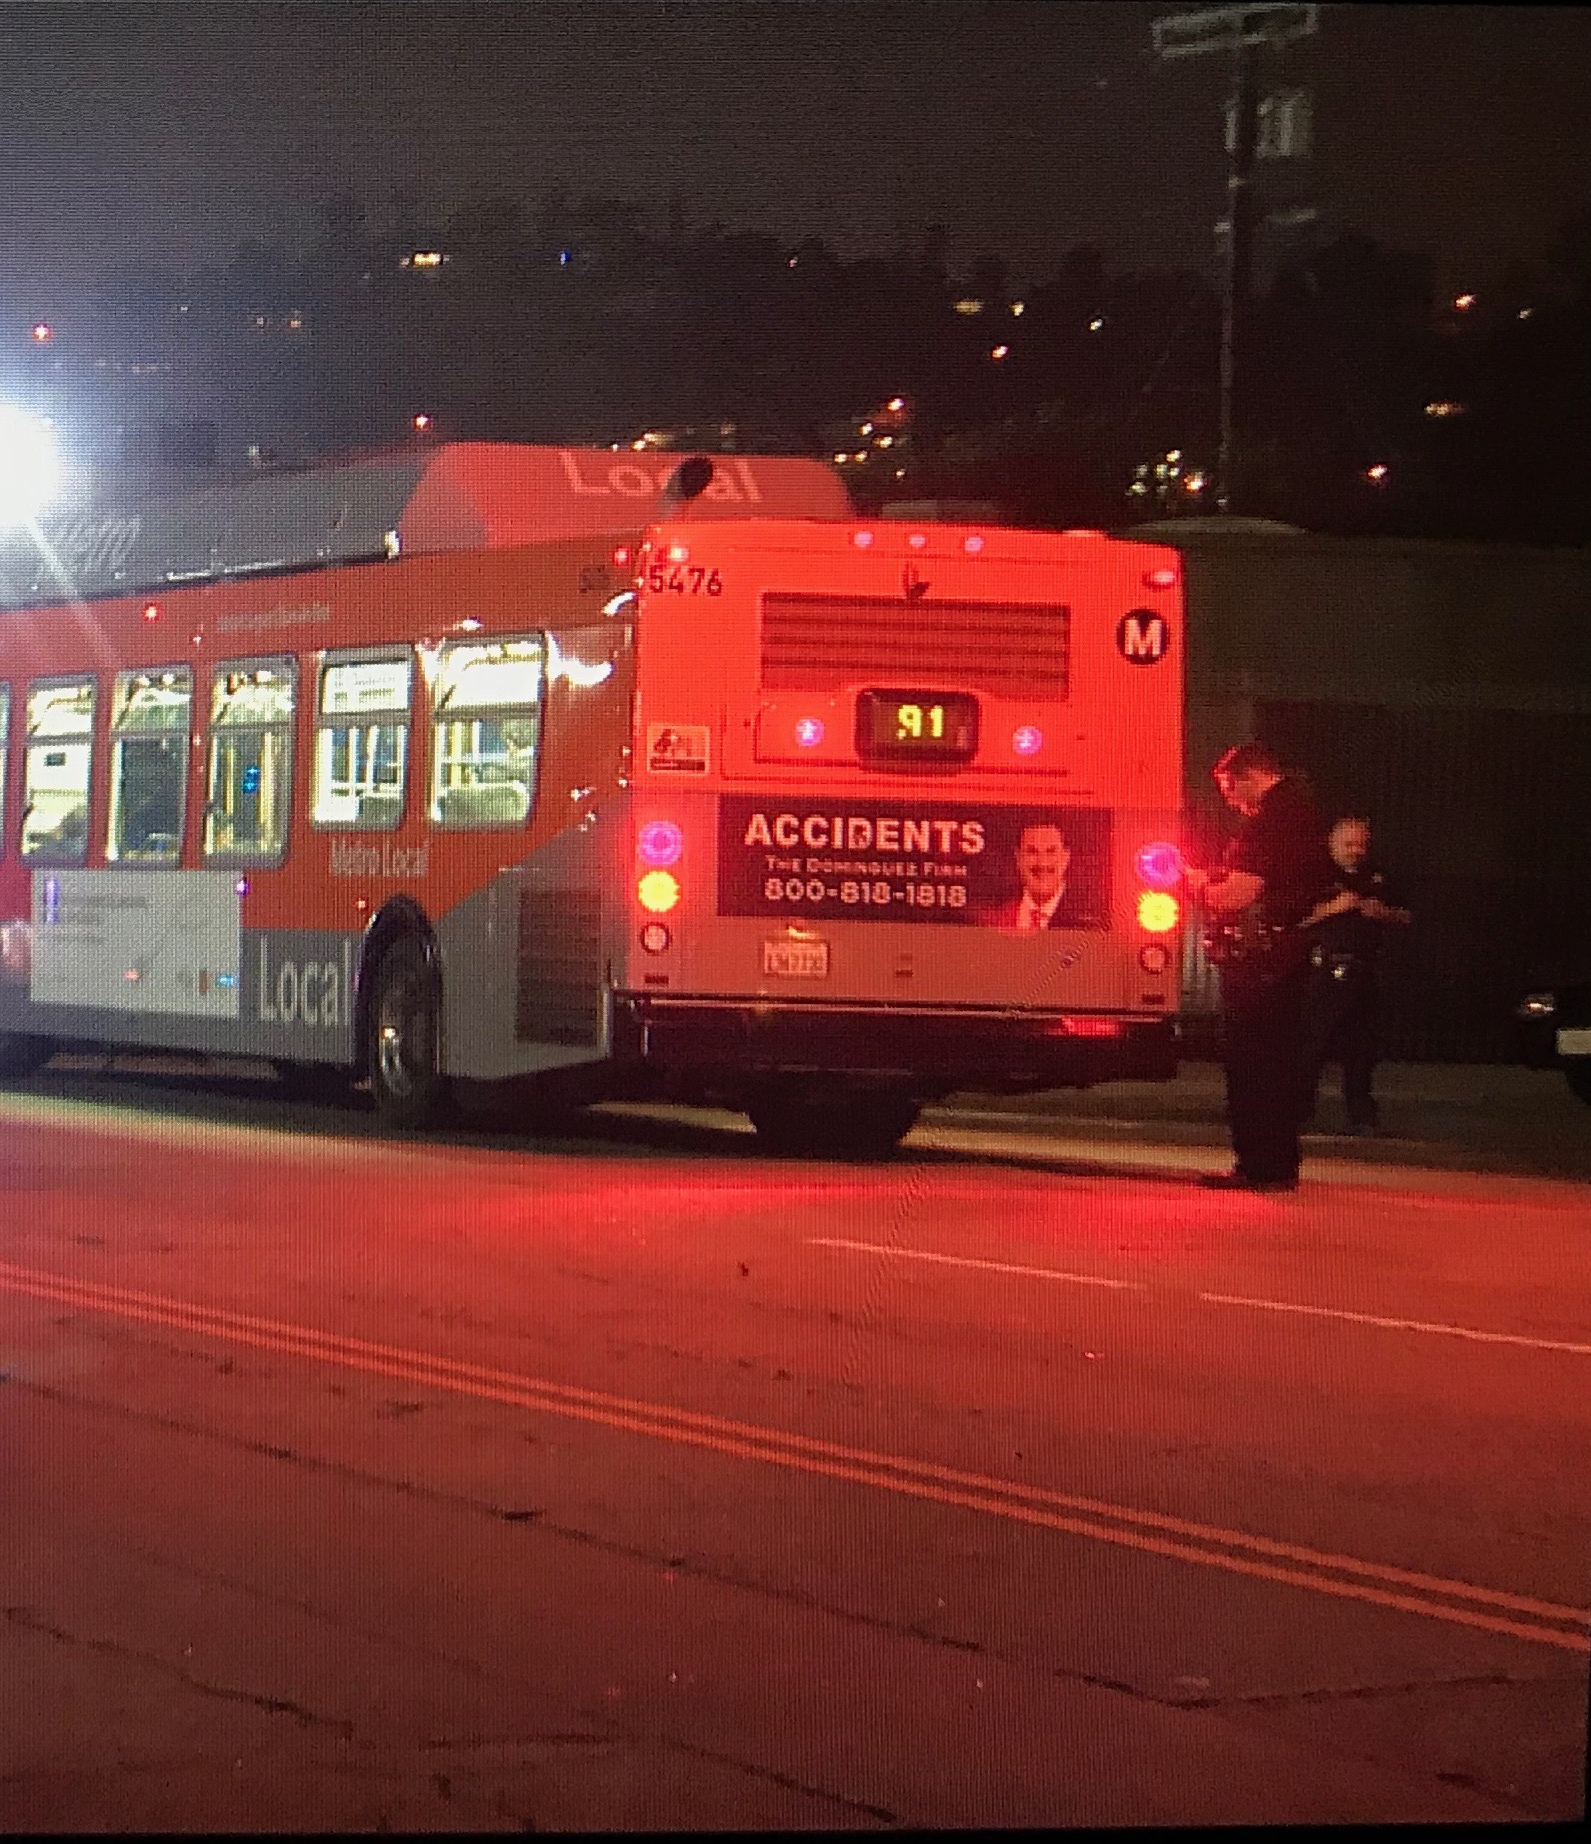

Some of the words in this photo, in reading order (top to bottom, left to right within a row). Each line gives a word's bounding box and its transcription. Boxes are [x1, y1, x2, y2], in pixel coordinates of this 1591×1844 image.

[647, 564, 723, 597] 5476
[1122, 618, 1164, 657] M
[897, 704, 944, 739] 91
[744, 812, 987, 854] ACCIDENTS
[382, 835, 431, 878] Local
[763, 877, 968, 908] 800-818-1818
[259, 932, 353, 1028] Local
